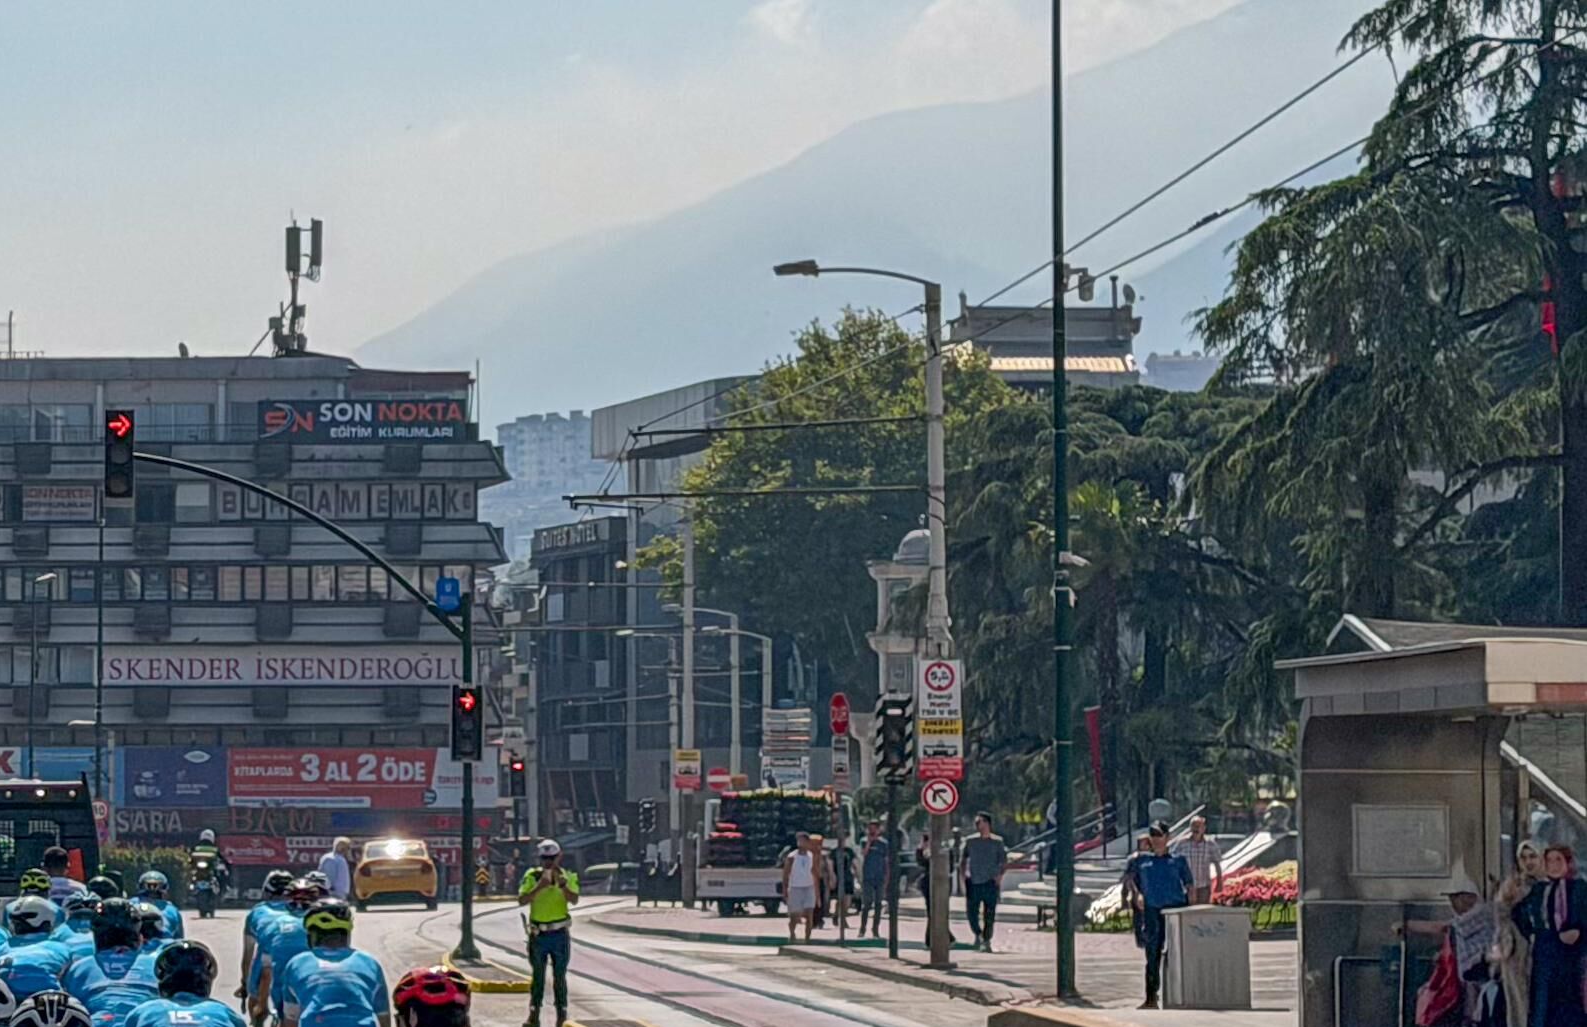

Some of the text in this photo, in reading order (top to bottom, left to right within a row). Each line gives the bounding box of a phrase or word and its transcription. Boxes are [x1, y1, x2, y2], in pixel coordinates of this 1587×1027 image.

[319, 402, 462, 422] SON NOKTA
[376, 490, 459, 516] EMLAK
[300, 753, 320, 782] 3
[324, 760, 352, 782] AL
[357, 753, 377, 782] 2
[381, 757, 426, 783] ÖDE
